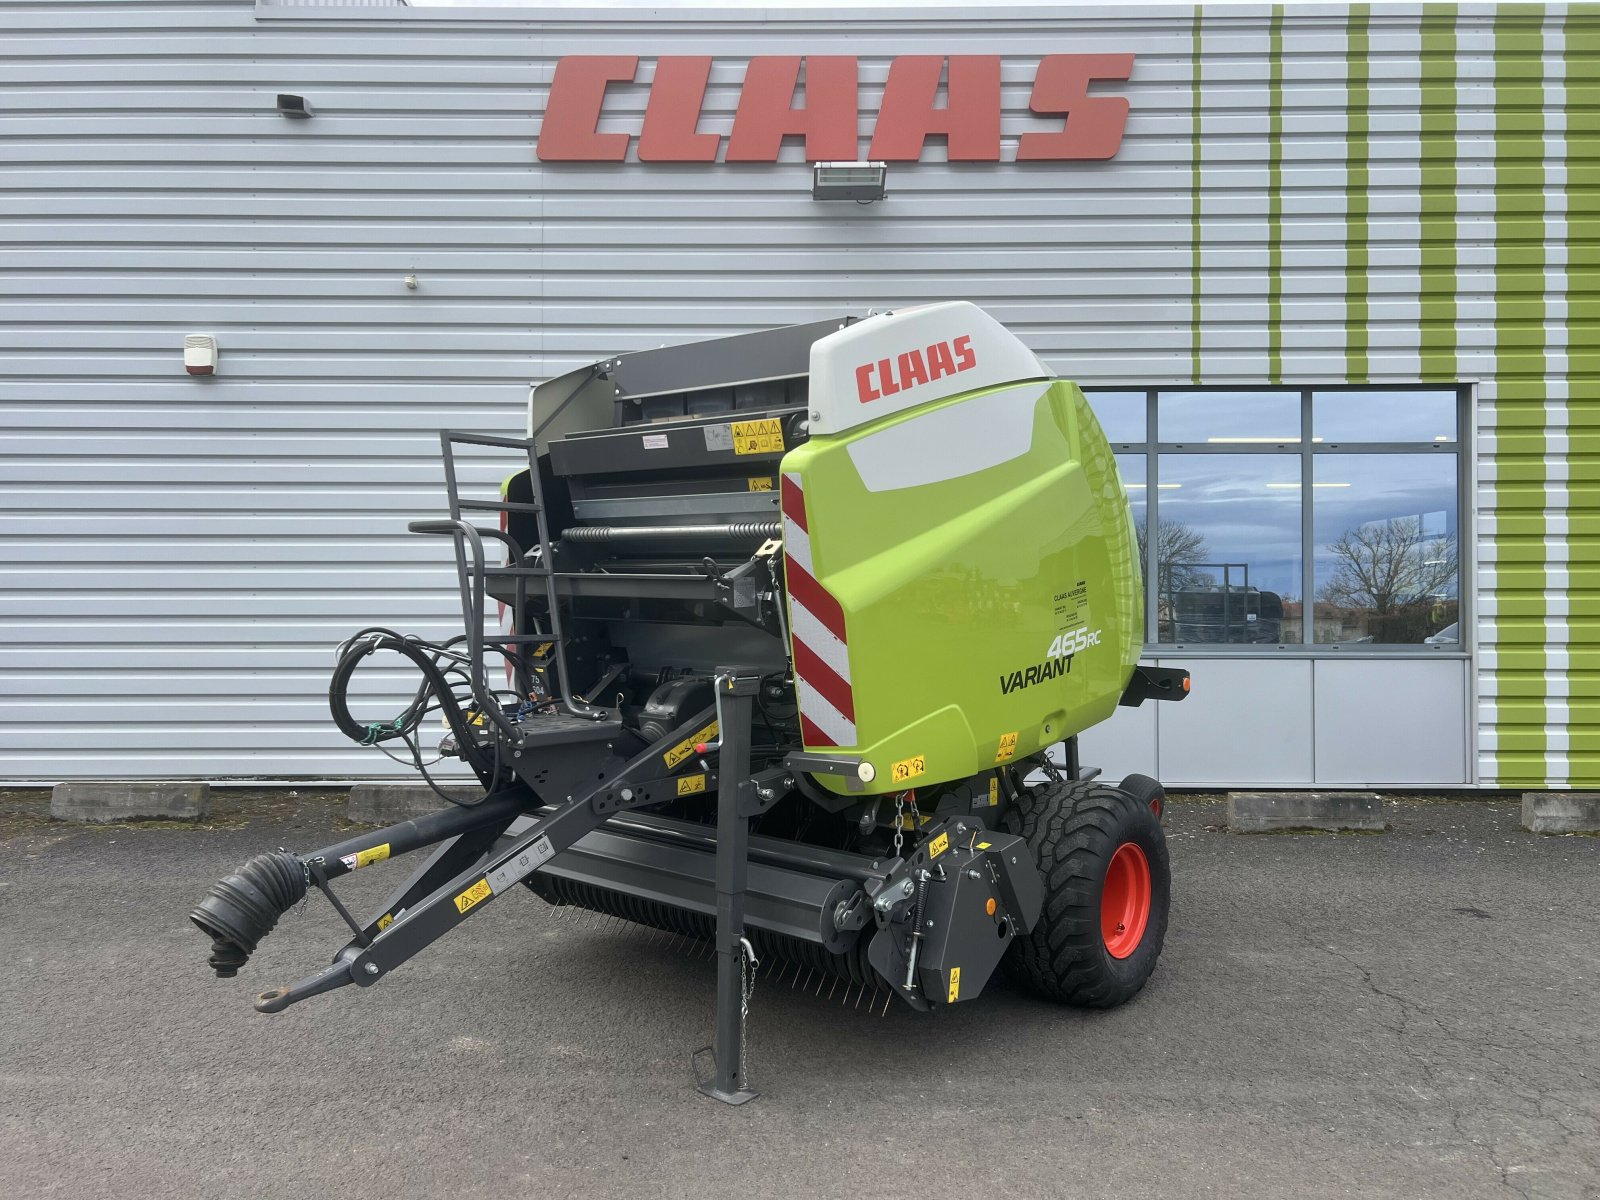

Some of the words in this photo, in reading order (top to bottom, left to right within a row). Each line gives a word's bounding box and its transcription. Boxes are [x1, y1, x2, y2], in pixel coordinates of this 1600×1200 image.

[536, 53, 1136, 164] CLAAS
[856, 335, 976, 404] CLAAS
[1054, 592, 1067, 602] CLAAS
[1000, 653, 1074, 695] VARIANT
